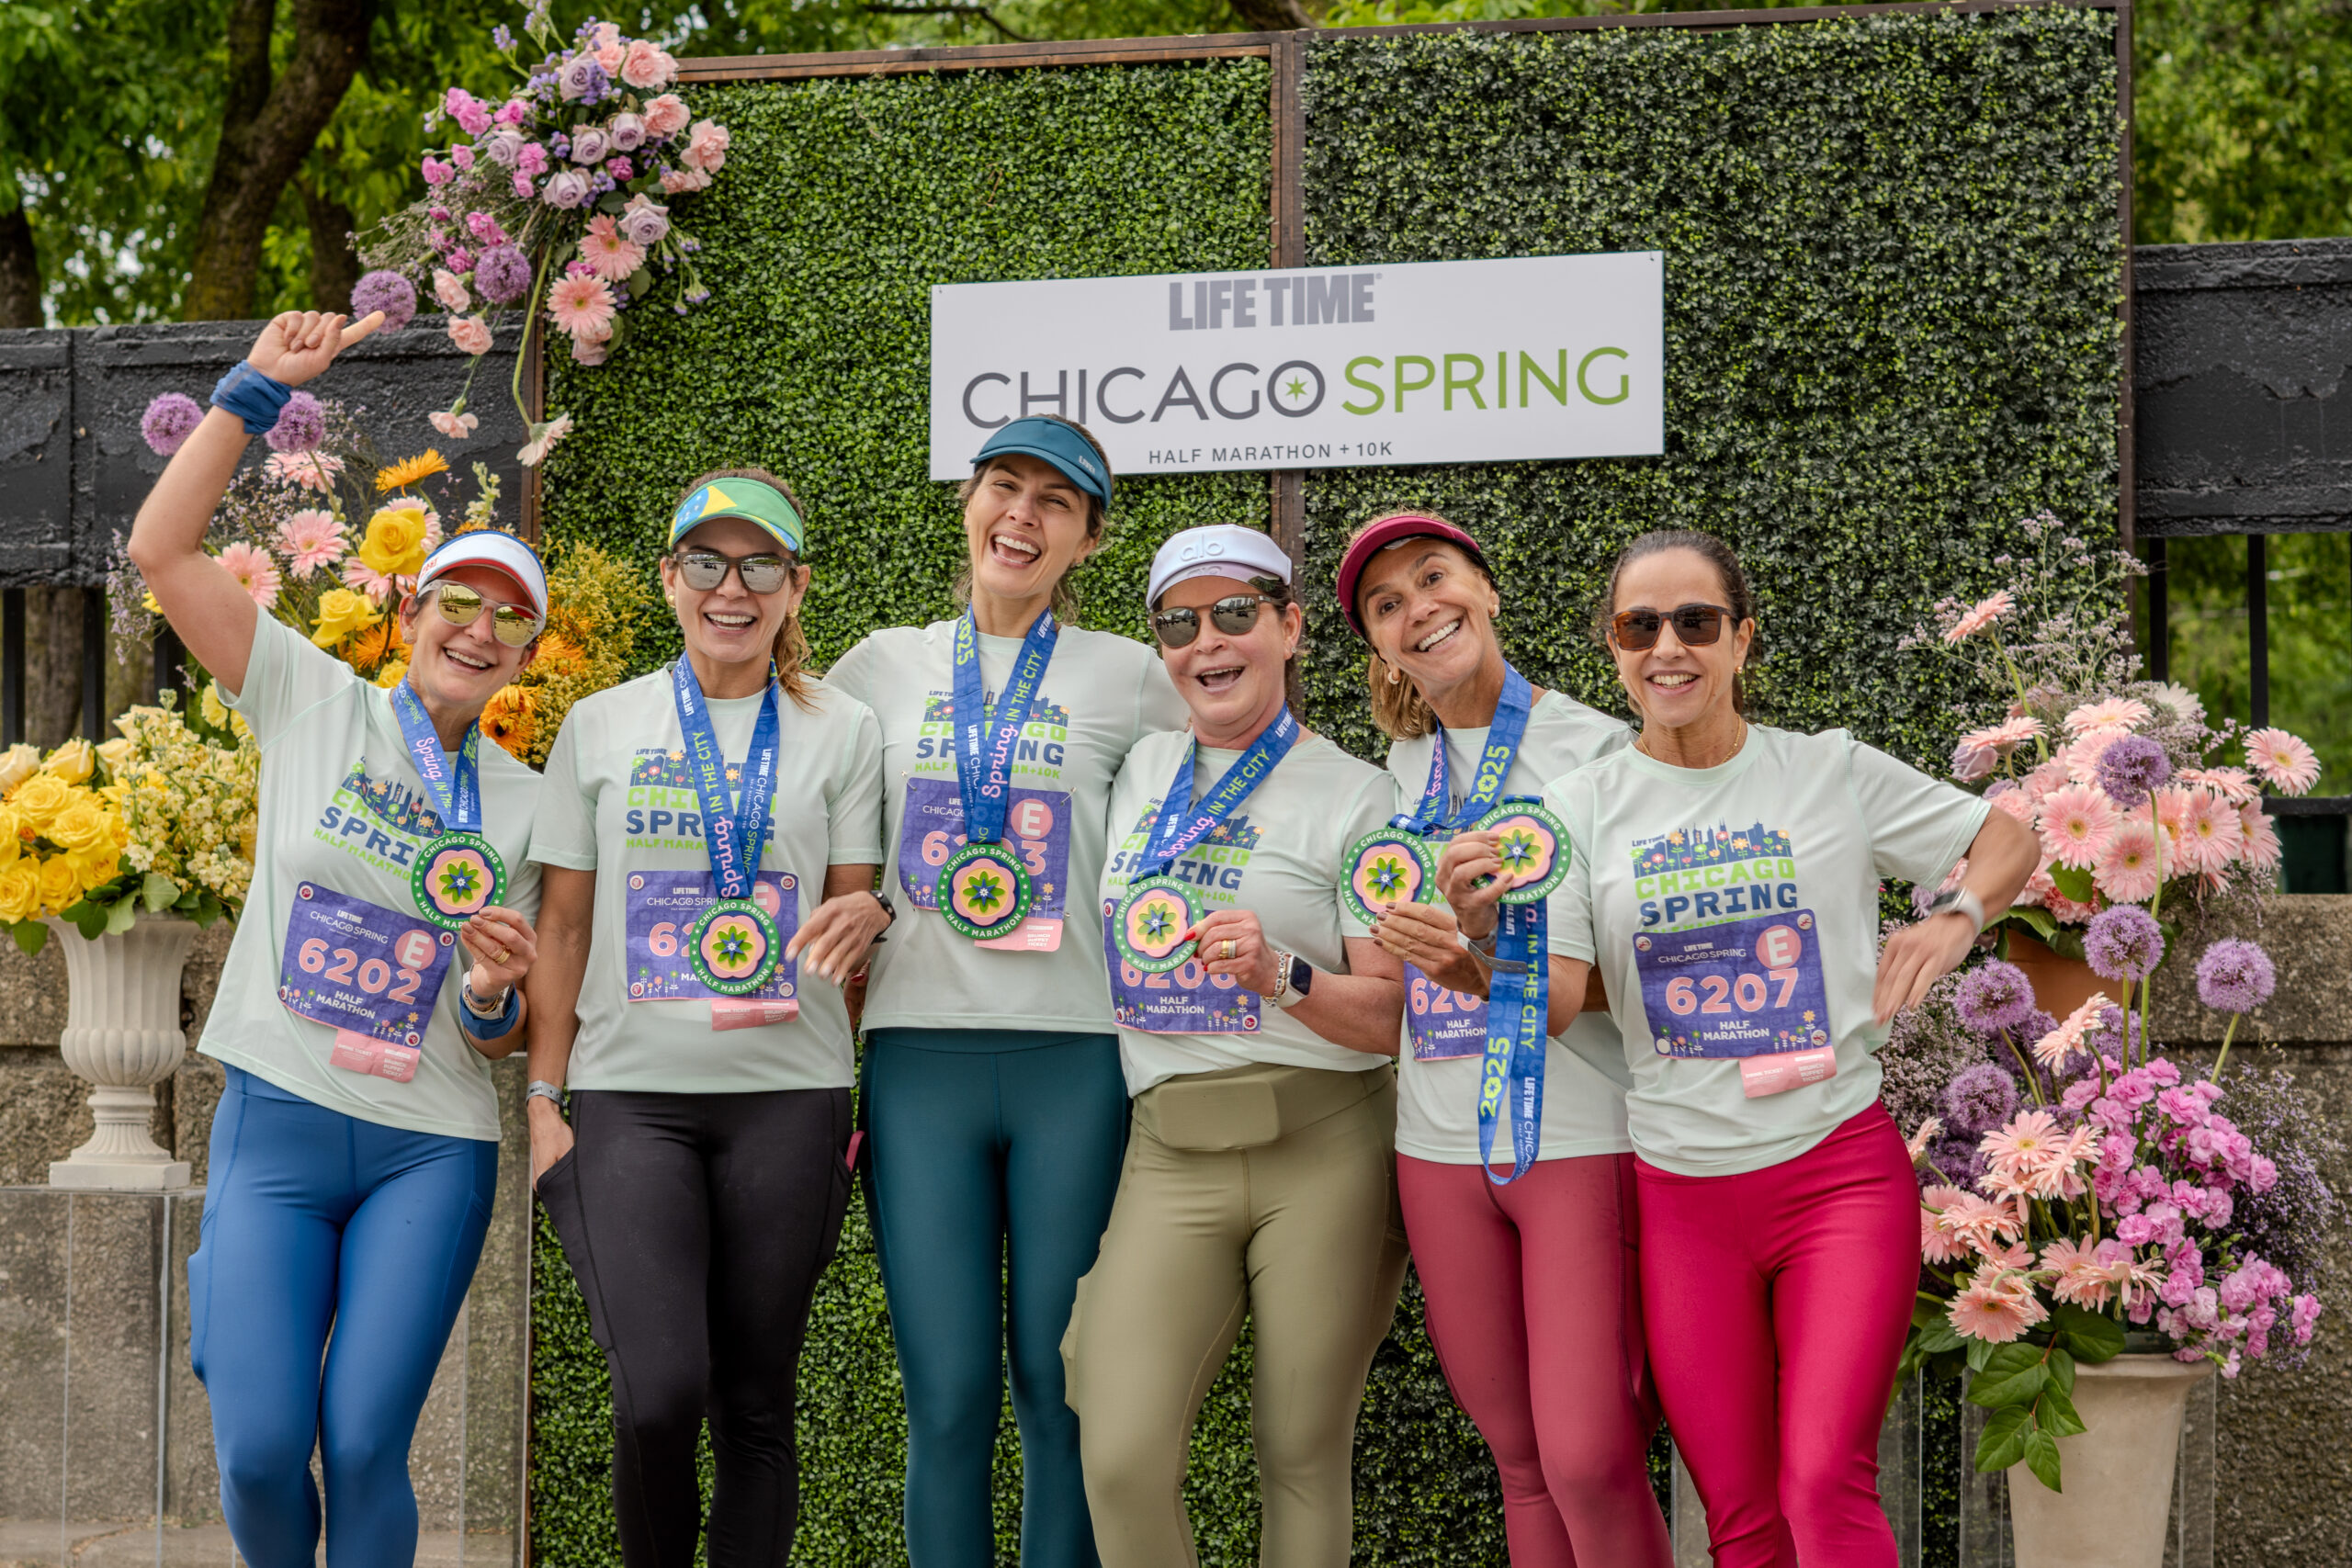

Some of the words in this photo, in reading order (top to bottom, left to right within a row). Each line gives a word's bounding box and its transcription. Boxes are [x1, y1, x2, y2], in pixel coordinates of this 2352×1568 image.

[963, 360, 1326, 430] CHICAGO
[1342, 346, 1630, 416] SPRING
[1149, 448, 1202, 464] HALF
[1212, 444, 1331, 462] MARATHON
[1356, 442, 1393, 457] 10K
[1180, 534, 1225, 561] alo
[956, 610, 975, 666] 2025
[1023, 649, 1043, 679] CITY
[1011, 680, 1032, 704] THE
[404, 696, 423, 725] SPRING
[1004, 707, 1022, 722] IN
[692, 731, 711, 761] CITY
[413, 737, 443, 781] Spring
[434, 782, 446, 791] IN
[915, 762, 949, 773] HALF
[981, 724, 1019, 798] Spring
[1471, 745, 1510, 803] 2025
[701, 762, 719, 792] THE
[708, 795, 724, 814] IN
[750, 777, 767, 829] CHICAGO
[1158, 815, 1216, 858] Spring
[1207, 800, 1227, 815] IN
[1218, 776, 1247, 801] THE
[1242, 749, 1271, 778] CITY
[1021, 803, 1044, 837] E
[1477, 805, 1523, 830] CHICAGO
[1526, 806, 1561, 830] SPRING
[320, 806, 420, 867] SPRI
[424, 836, 465, 858] CHICAGO
[469, 838, 499, 863] SPRING
[626, 838, 661, 849] HALF
[1360, 830, 1404, 847] CHICAGO
[1406, 836, 1431, 868] SPRING
[1632, 838, 1647, 847] LIFE
[1648, 834, 1666, 843] TIME
[313, 828, 348, 849] HALF
[347, 844, 413, 882] MARATHO
[714, 816, 743, 899] Spring
[946, 847, 986, 872] CHICAGO
[989, 848, 1022, 872] SPRING
[1501, 875, 1559, 901] MARATHON
[1634, 857, 1796, 901] CHICAGO
[420, 901, 441, 922] HALF
[647, 897, 694, 906] CHICAGO
[1117, 883, 1148, 919] CHICAGO
[1150, 878, 1184, 891] SPRING
[1344, 889, 1362, 915] HALF
[1639, 883, 1798, 927] SPRING
[310, 910, 354, 932] CHICAGO
[353, 926, 389, 944] SPRING
[698, 902, 737, 926] CHICAGO
[741, 903, 770, 926] SPRING
[947, 914, 968, 932] HALF
[971, 913, 1022, 938] MARATHON
[401, 932, 430, 968] E
[1133, 958, 1157, 970] HALF
[1159, 944, 1193, 969] MARATH
[1527, 934, 1538, 954] IN
[1657, 953, 1709, 964] CHICAGO
[1709, 948, 1747, 959] SPRING
[1766, 929, 1792, 966] E
[299, 937, 422, 1004] 6202
[698, 968, 718, 987] HALF
[720, 968, 770, 992] MARATHON
[1523, 960, 1539, 999] THE
[334, 990, 364, 1006] HALF
[1159, 996, 1189, 1005] HALF
[1410, 977, 1482, 1016] 620
[1665, 967, 1798, 1015] 6207
[316, 994, 376, 1020] MARATHON
[1146, 1005, 1205, 1014] MARATHON
[1435, 1027, 1487, 1040] MARATHON
[1446, 1019, 1470, 1029] HALF
[1521, 1004, 1537, 1051] CITY
[1702, 1028, 1770, 1041] MARATHON
[1719, 1021, 1750, 1031] HALF
[1480, 1037, 1510, 1118] 2025
